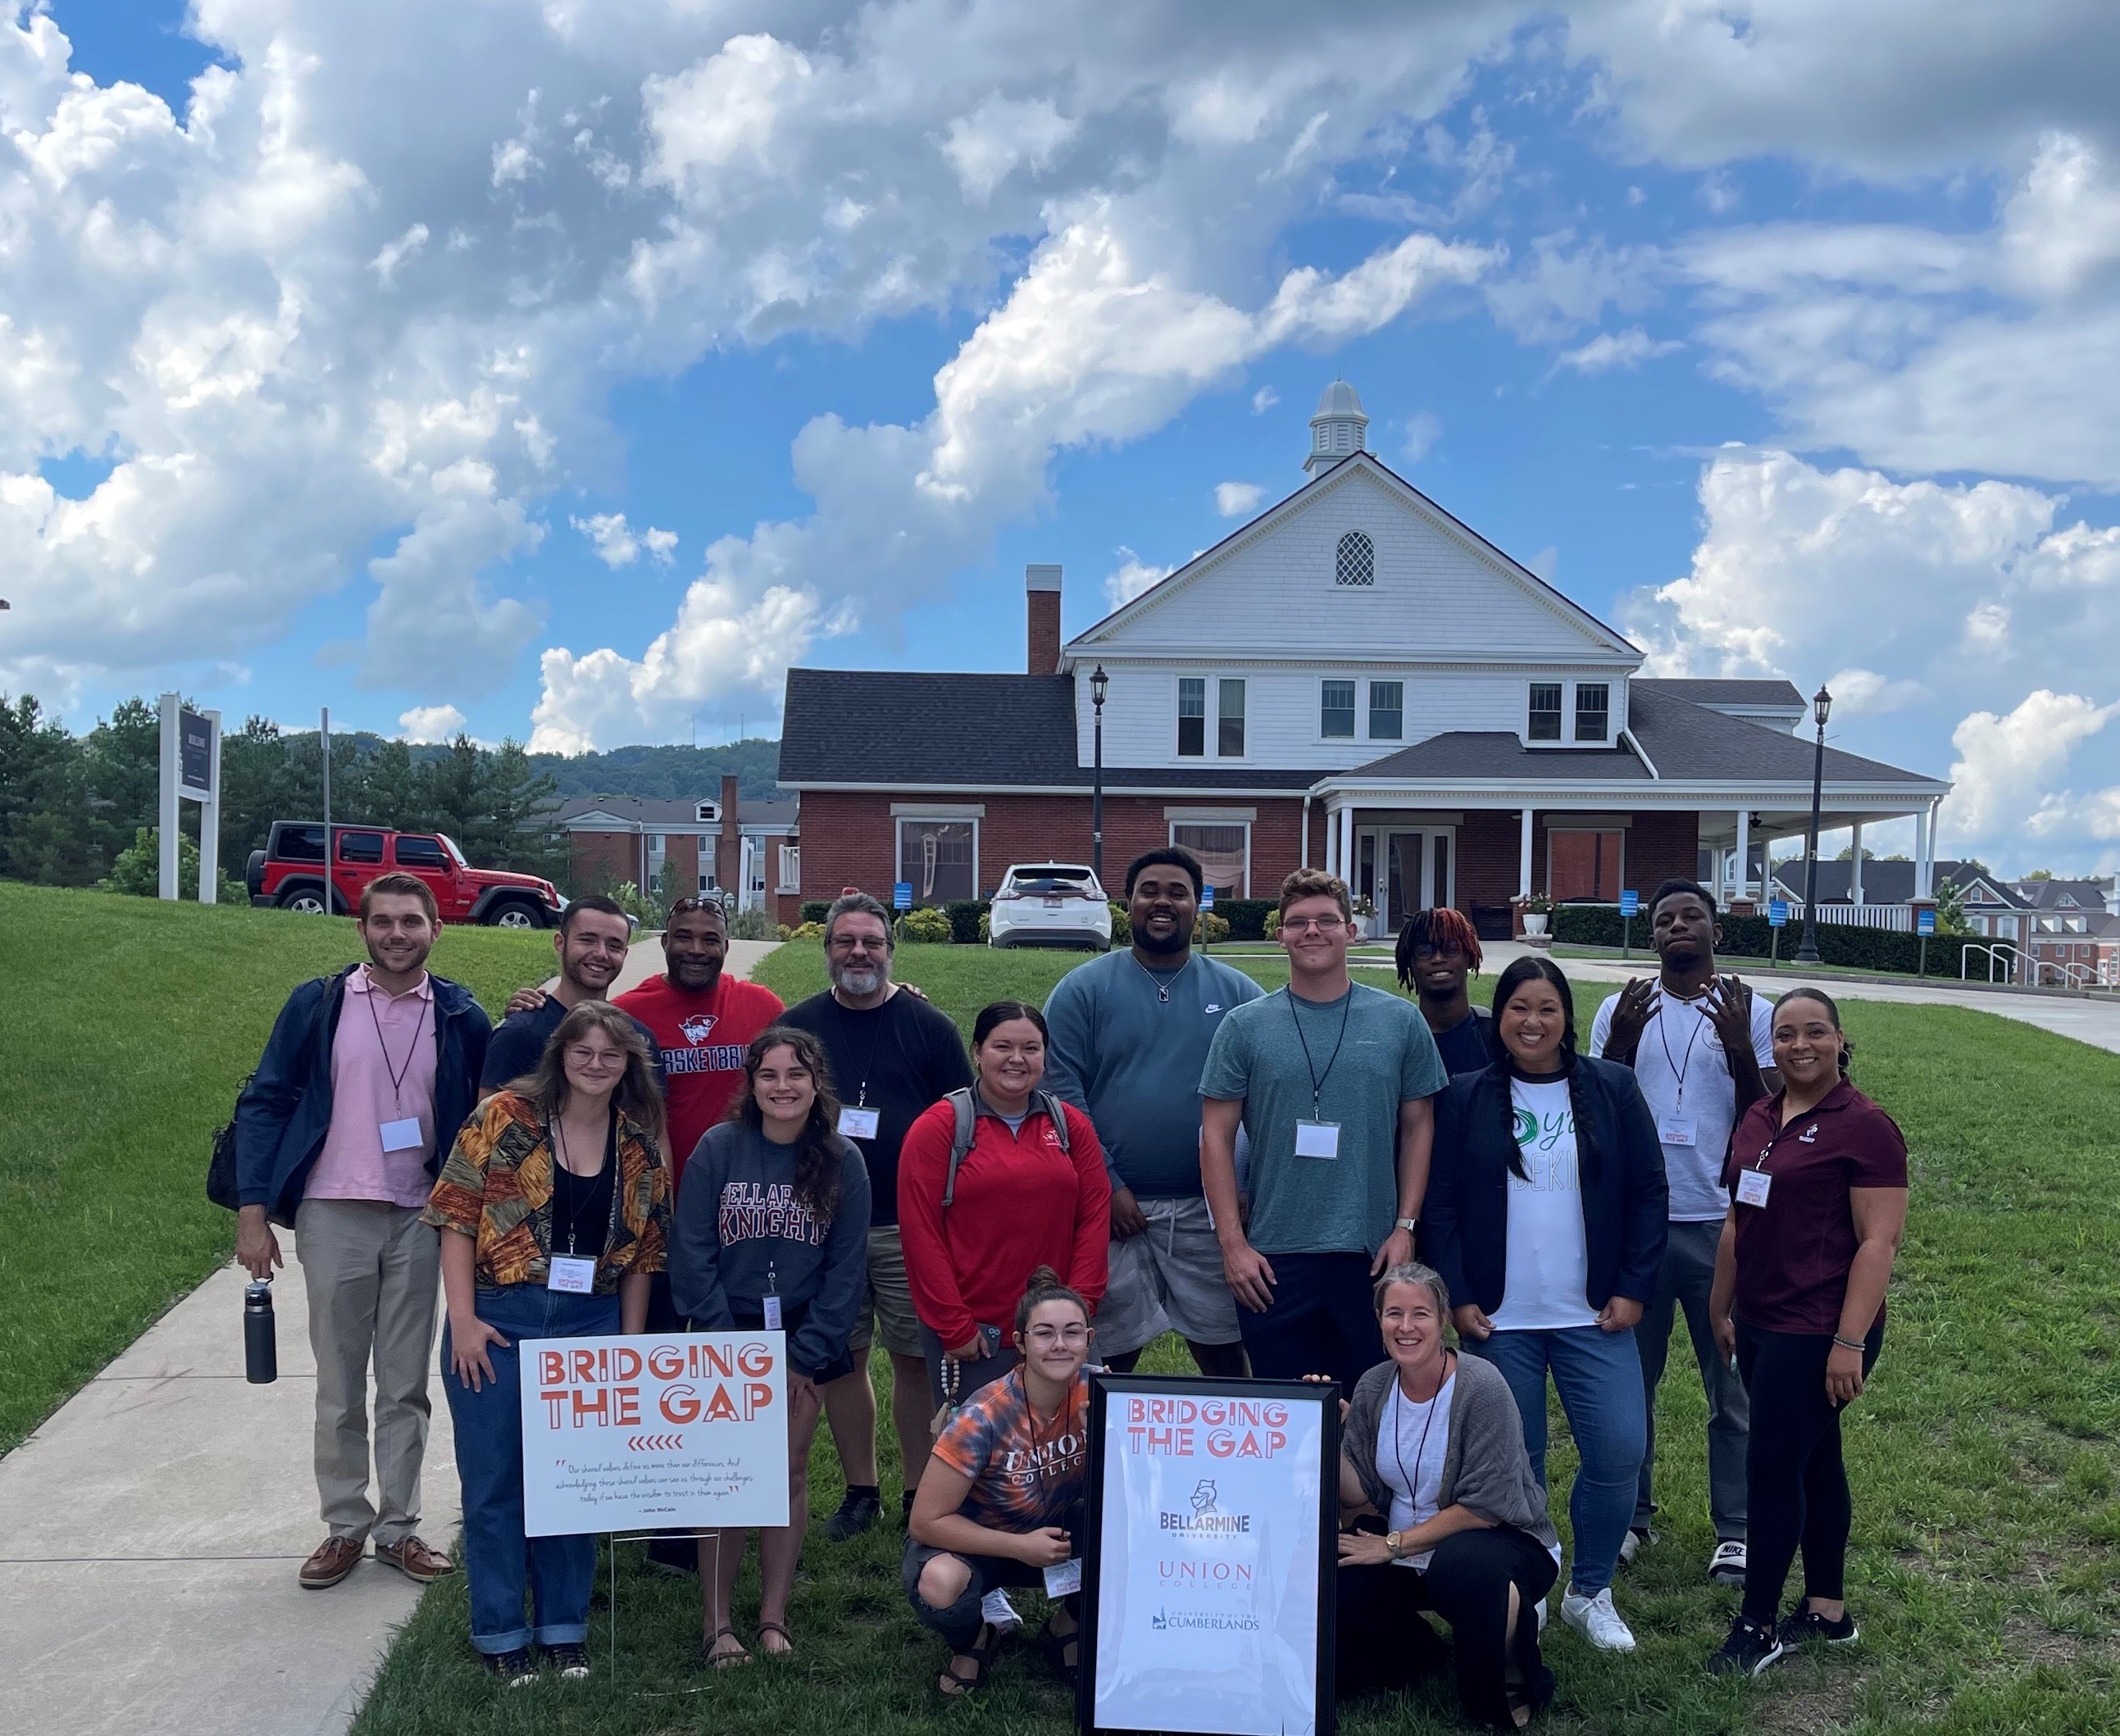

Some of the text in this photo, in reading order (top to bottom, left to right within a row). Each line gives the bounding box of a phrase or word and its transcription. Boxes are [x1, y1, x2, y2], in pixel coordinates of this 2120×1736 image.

[719, 1207, 831, 1248] KNIGHT
[539, 1343, 773, 1385] BRIDGING
[540, 1383, 773, 1429] THE GAP
[1128, 1398, 1288, 1428] BRIDGING
[1127, 1427, 1286, 1459] THE GAP
[1160, 1511, 1250, 1533] BELLARMINE
[1159, 1561, 1252, 1581] UNION
[1160, 1579, 1252, 1590] COLLEGE
[1168, 1616, 1259, 1630] CUMBERLANDS
